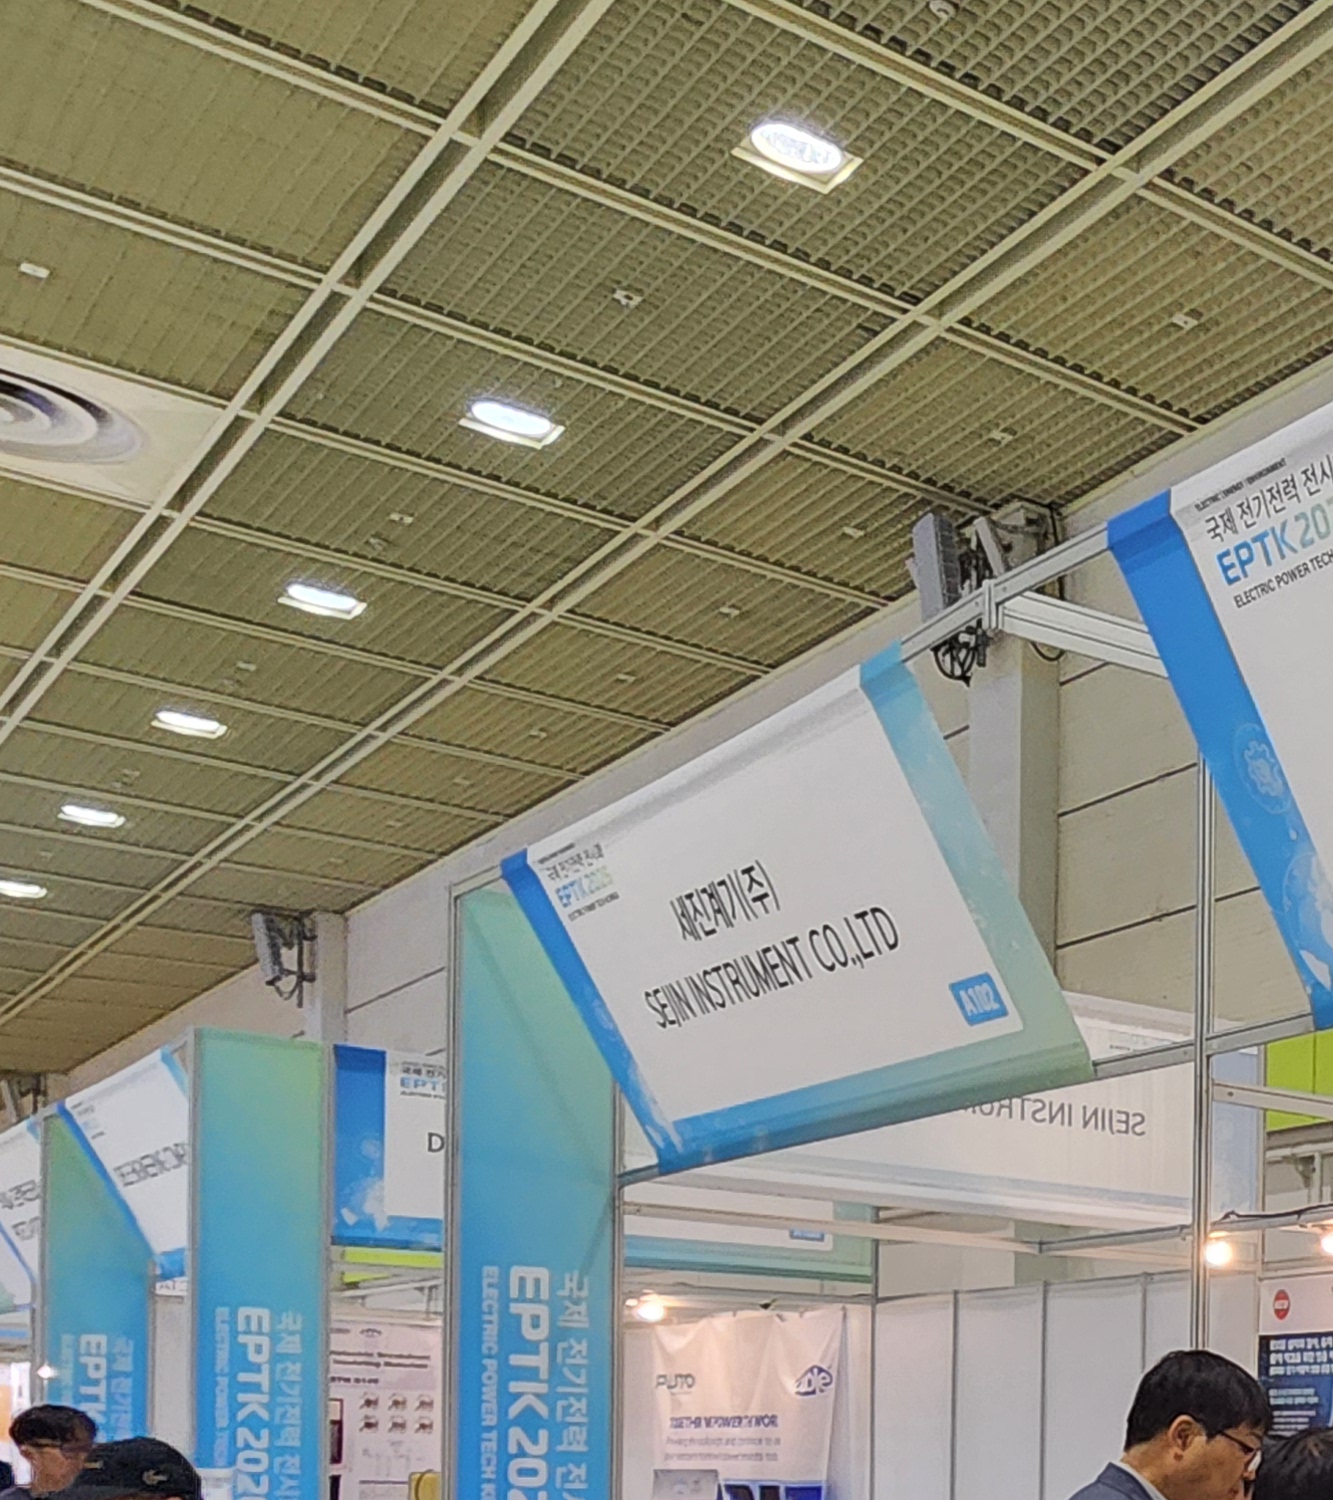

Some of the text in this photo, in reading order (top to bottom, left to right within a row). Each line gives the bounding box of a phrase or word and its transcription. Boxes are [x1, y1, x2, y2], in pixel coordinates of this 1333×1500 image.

[1205, 506, 1238, 542] 국제
[1239, 474, 1301, 529] 전기전력
[1233, 579, 1276, 608] ELECTRIC
[1275, 562, 1310, 589] POWER
[670, 859, 781, 942] 세진계기(주)
[643, 905, 900, 1029] SEJIN INSTRUMENT CO.,LTD
[963, 983, 1000, 1016] A102
[481, 1265, 500, 1355] ELECTRIC
[557, 1270, 590, 1328] 국제
[481, 1359, 498, 1426] POWER
[555, 1338, 589, 1453] 전기전력
[480, 1430, 497, 1479] TECH
